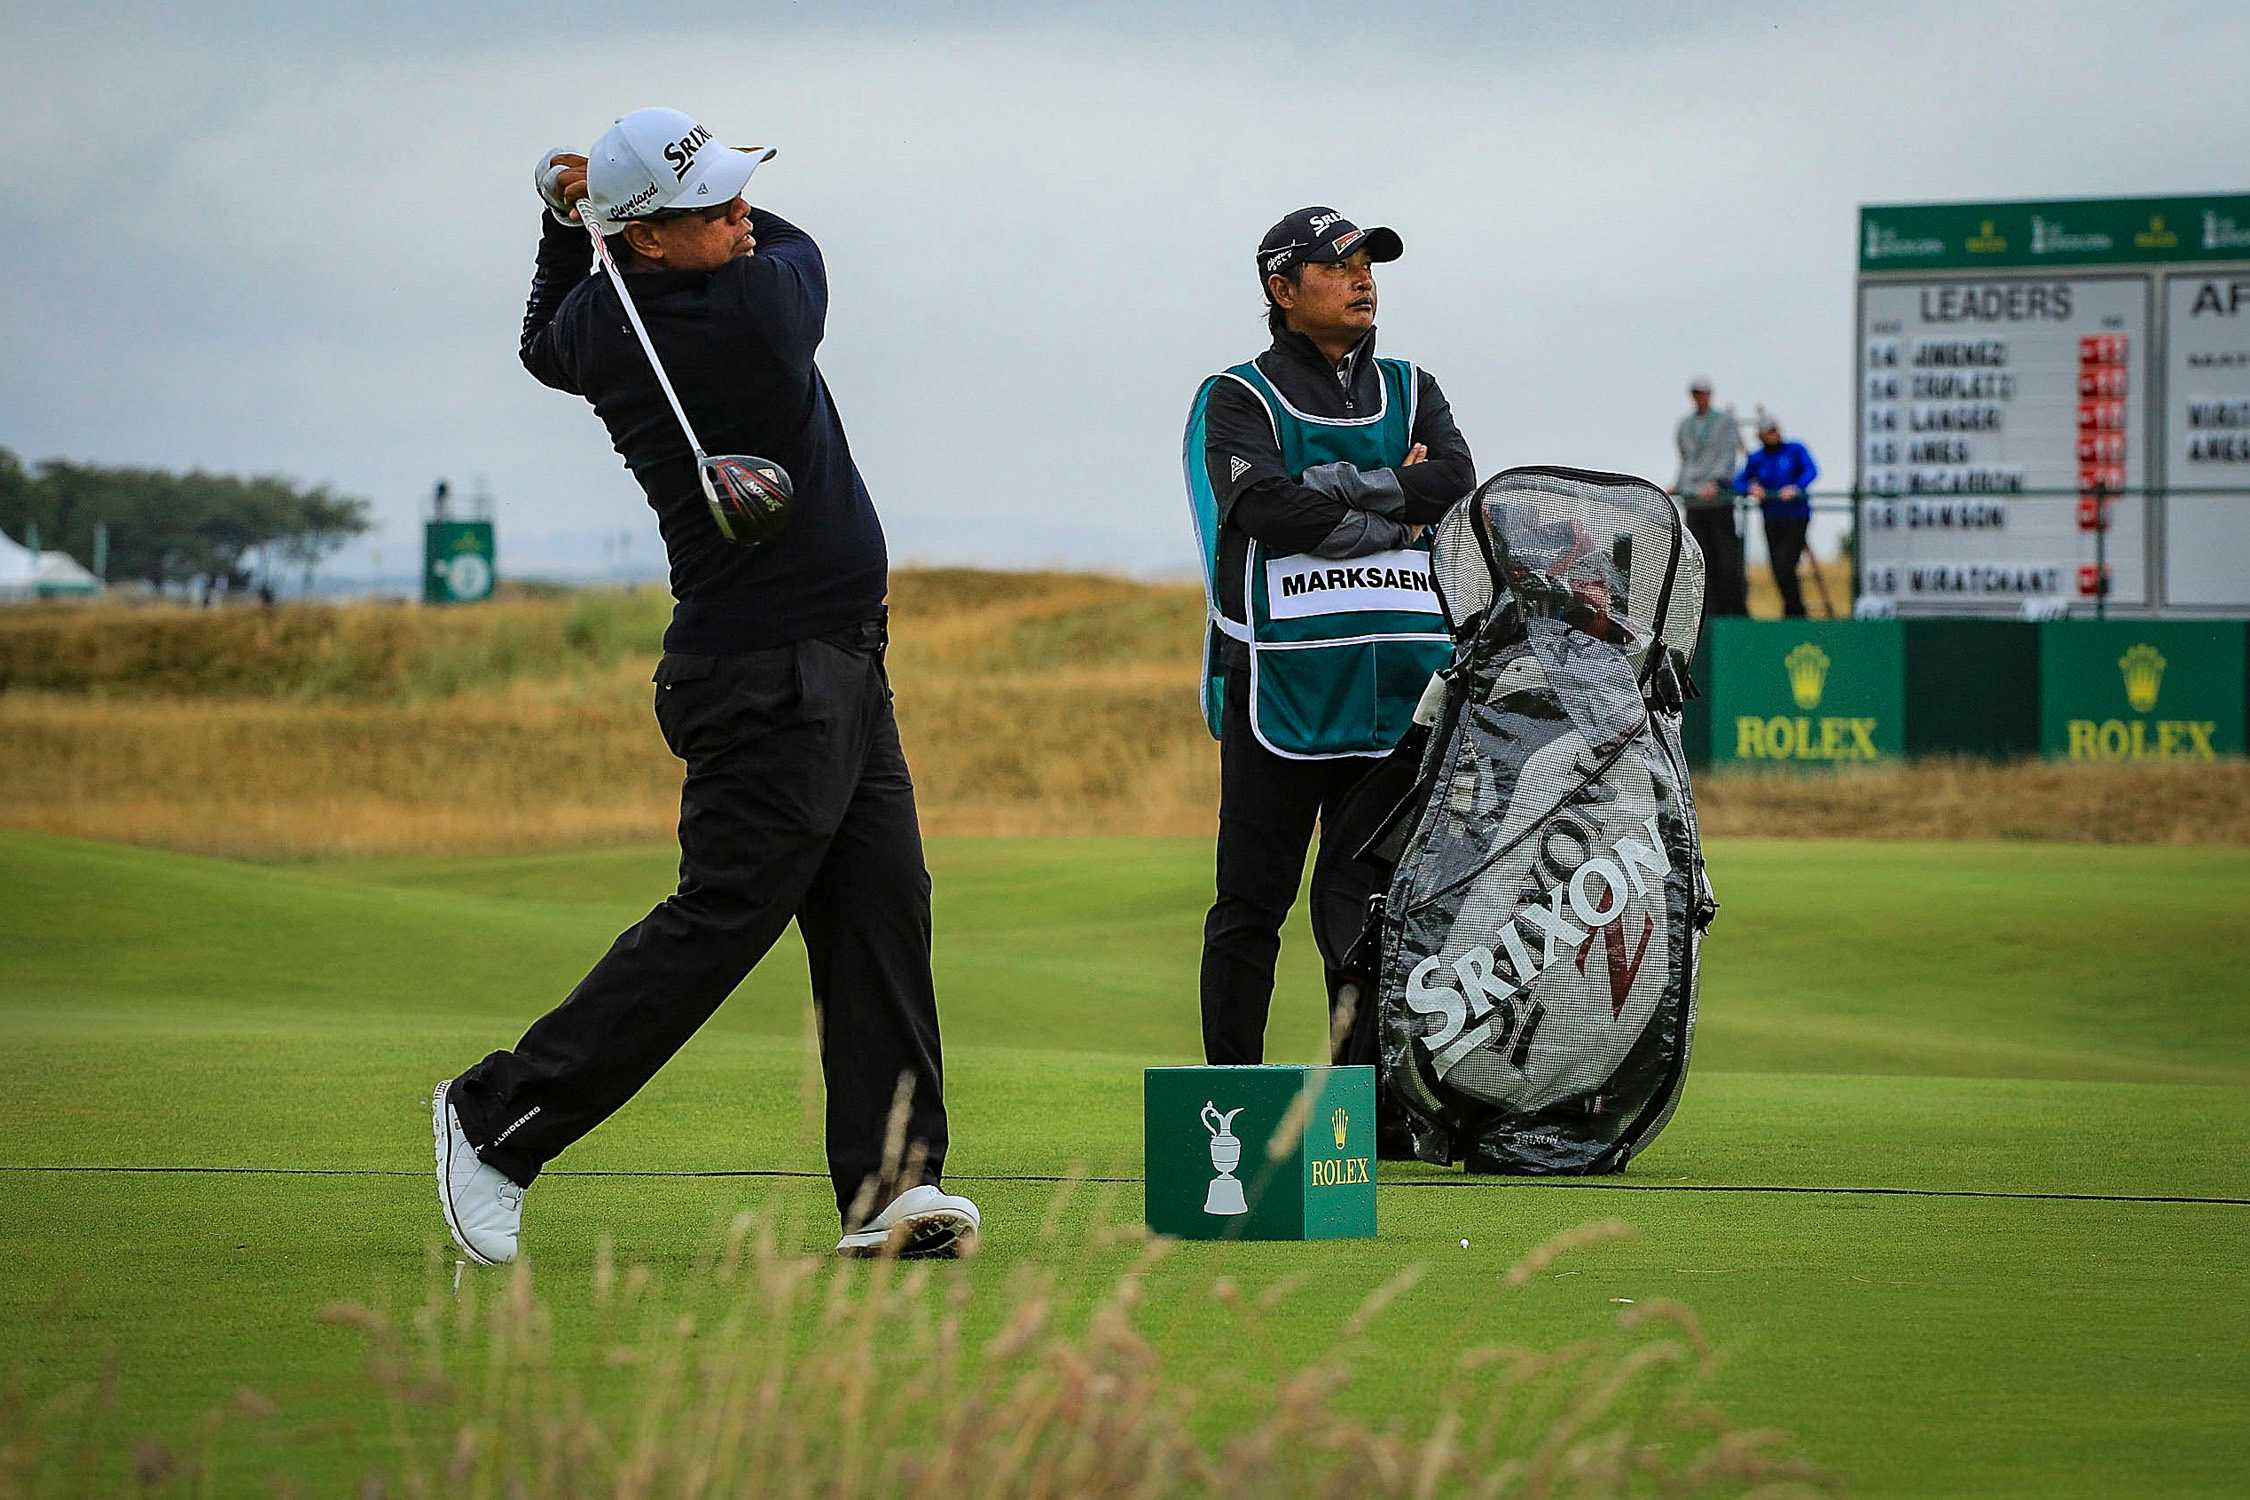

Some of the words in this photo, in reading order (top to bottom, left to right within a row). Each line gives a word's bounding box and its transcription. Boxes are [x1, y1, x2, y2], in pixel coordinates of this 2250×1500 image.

[610, 182, 659, 219] Cleveland
[1921, 283, 2073, 321] LEADERS
[1736, 715, 1879, 760] ROLEX
[2068, 719, 2216, 763] ROLEX
[1405, 816, 1672, 1082] SRIXON
[1311, 1157, 1370, 1187] ROLEX
